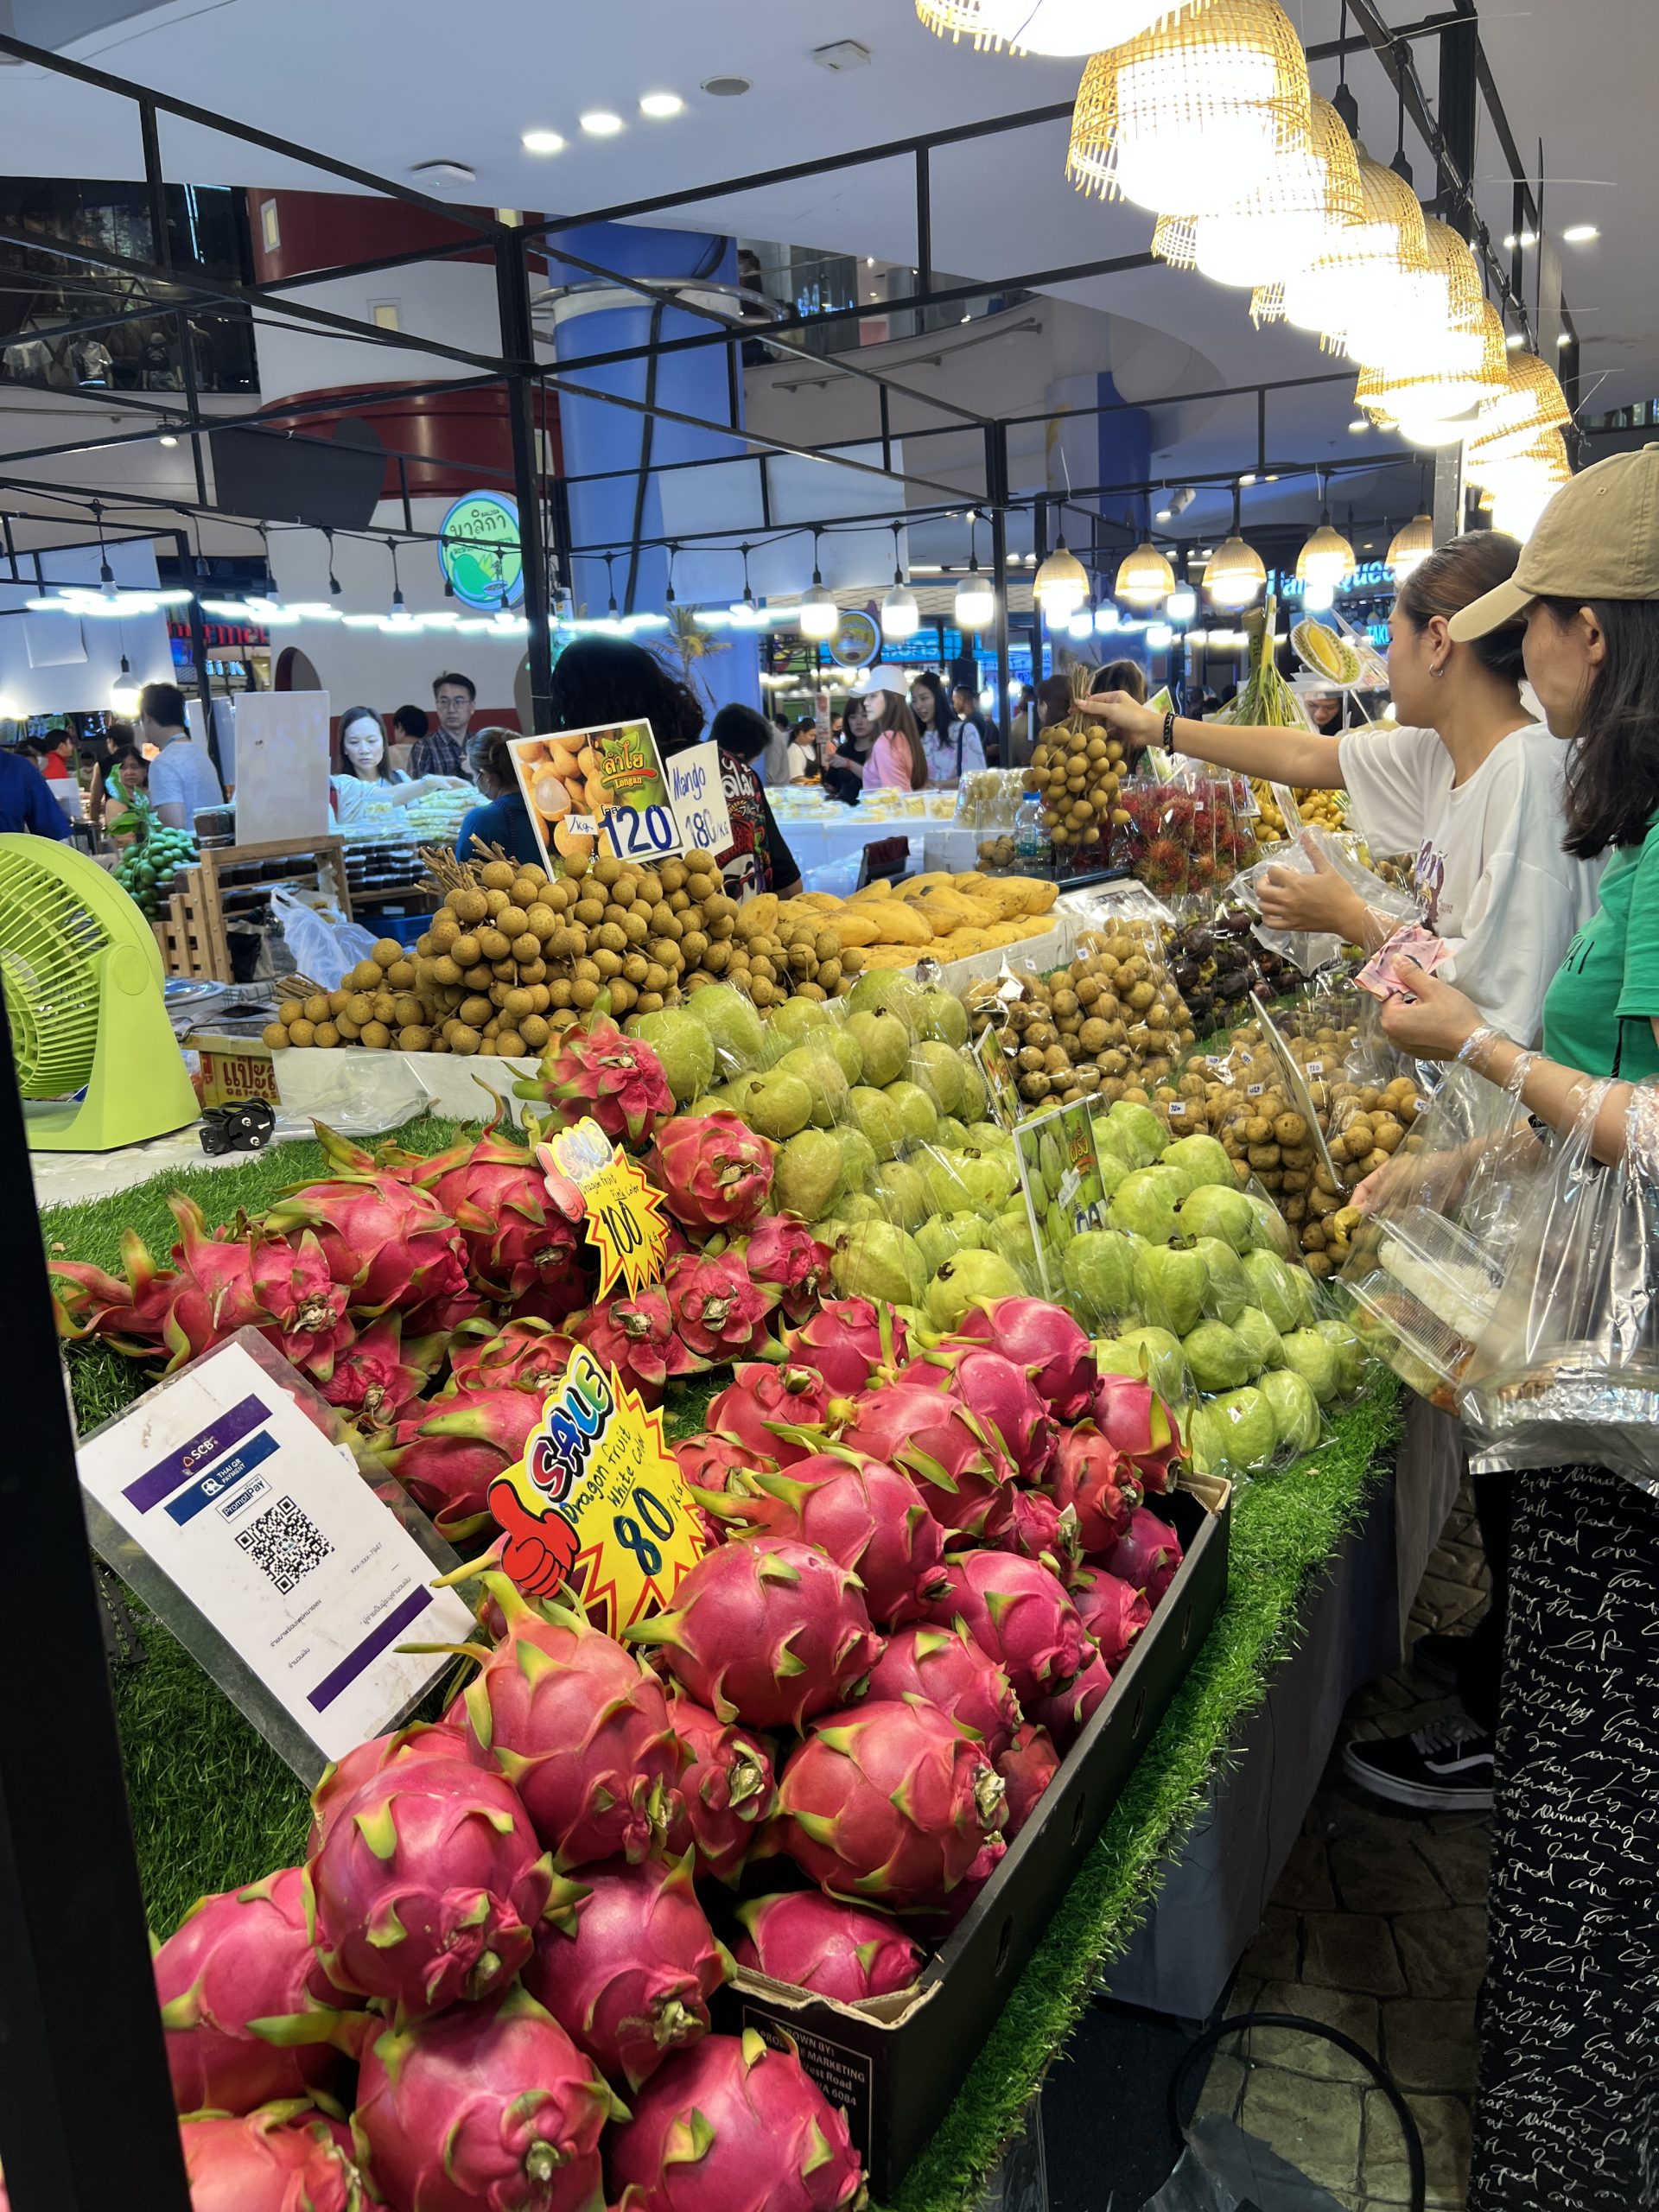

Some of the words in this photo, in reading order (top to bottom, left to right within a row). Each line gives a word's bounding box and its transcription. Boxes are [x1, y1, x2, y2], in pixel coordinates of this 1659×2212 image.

[602, 740, 645, 775] ลำไย
[614, 777, 642, 789] Longan
[673, 762, 706, 802] Mango
[598, 804, 672, 858] 120
[685, 809, 716, 849] 180
[558, 1122, 613, 1181] SALE
[600, 1200, 643, 1257] 100
[191, 1438, 214, 1459] SCB
[532, 1355, 614, 1503] SALE
[217, 1465, 233, 1478] THAI
[232, 1458, 242, 1467] QR
[221, 1463, 246, 1484] PAYMENT
[607, 1465, 634, 1507] White
[558, 1465, 609, 1525] Dragon
[613, 1486, 674, 1576] 80
[807, 2049, 865, 2084] MARKETING
[826, 2072, 853, 2091] Road
[831, 2088, 857, 2107] 6084
